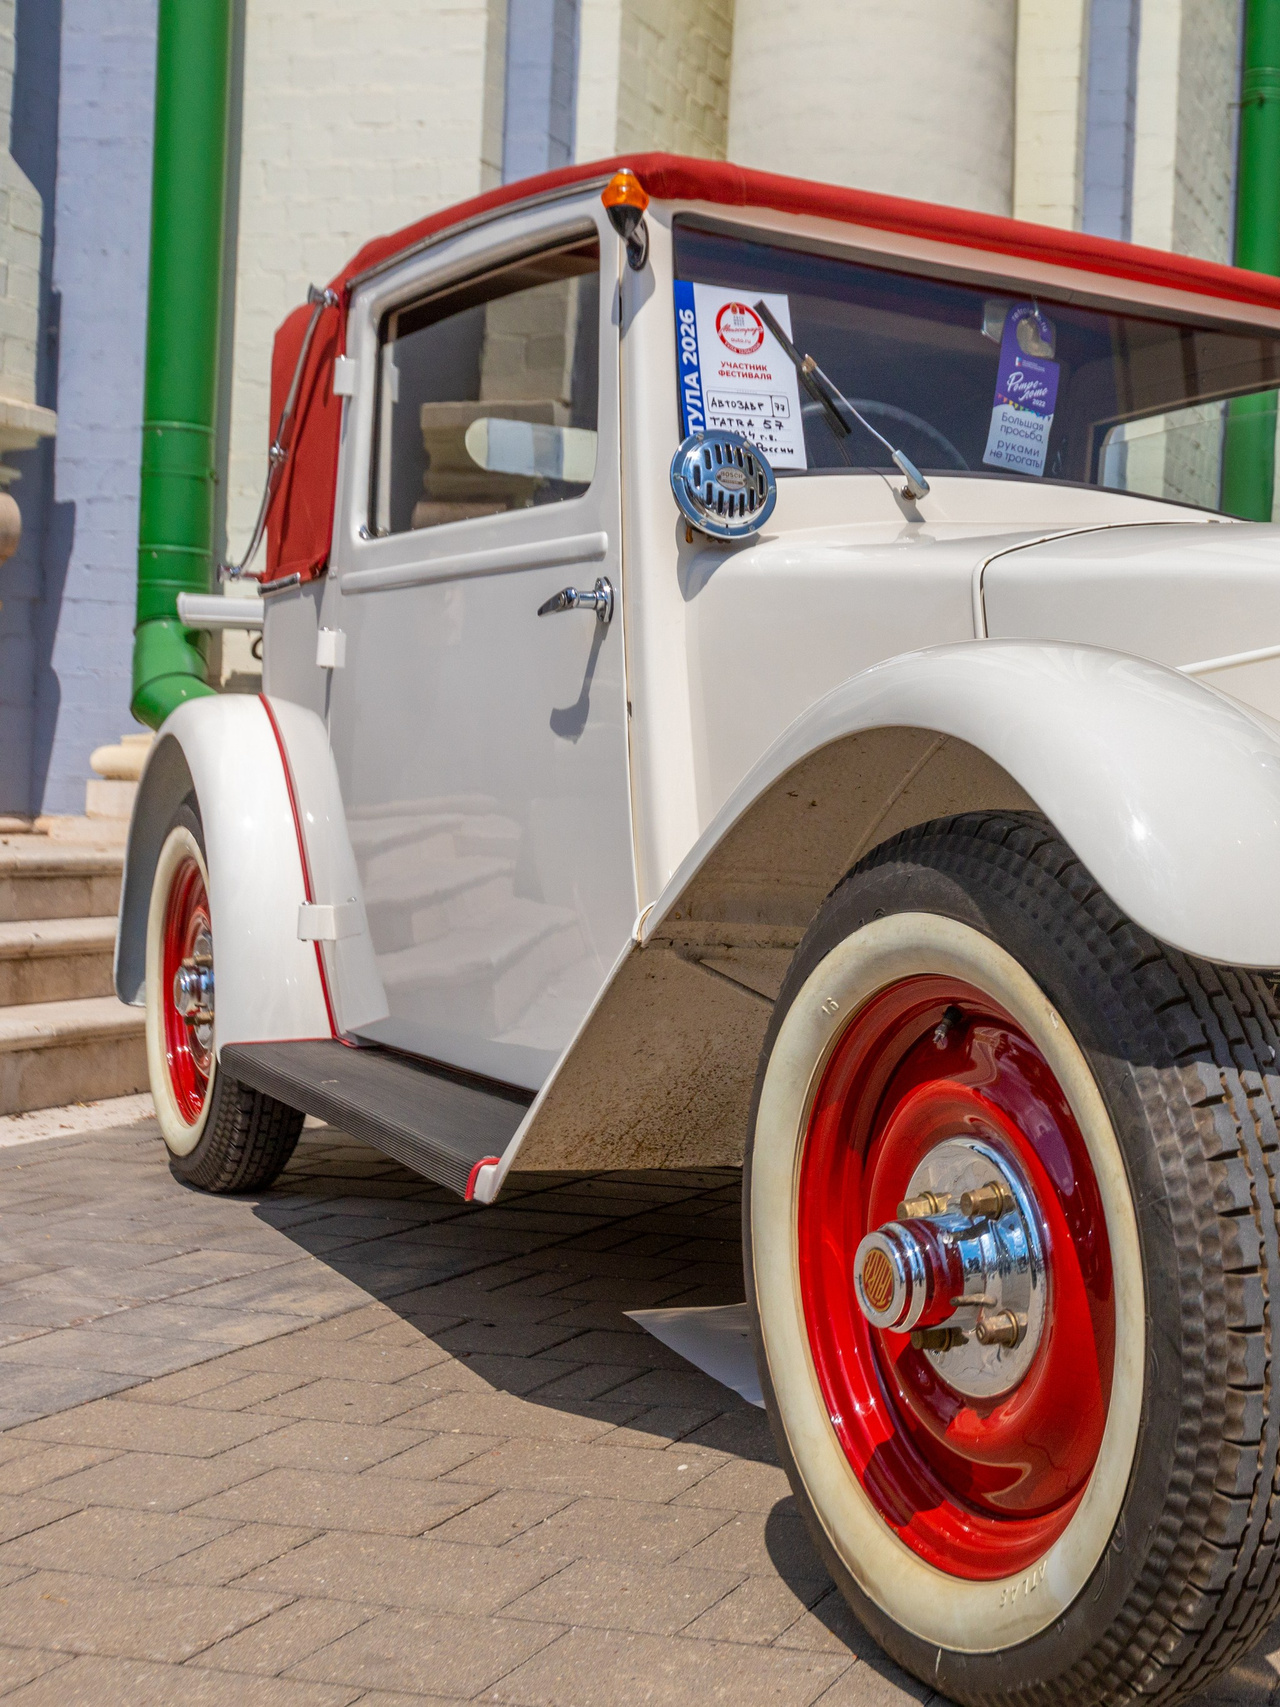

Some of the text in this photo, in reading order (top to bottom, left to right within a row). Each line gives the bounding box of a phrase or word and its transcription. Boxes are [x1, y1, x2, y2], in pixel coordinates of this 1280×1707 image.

[679, 308, 704, 436] ТУЛА 2026
[718, 369, 772, 381] ФЕСТИВАЛЯ
[720, 360, 768, 372] УЧАСТНИК
[709, 416, 784, 431] TATRA 57
[1001, 411, 1044, 432] Большая
[1000, 424, 1044, 444] просьба,
[756, 442, 794, 455] России
[997, 440, 1040, 458] руками
[989, 449, 1043, 469] не трогать!
